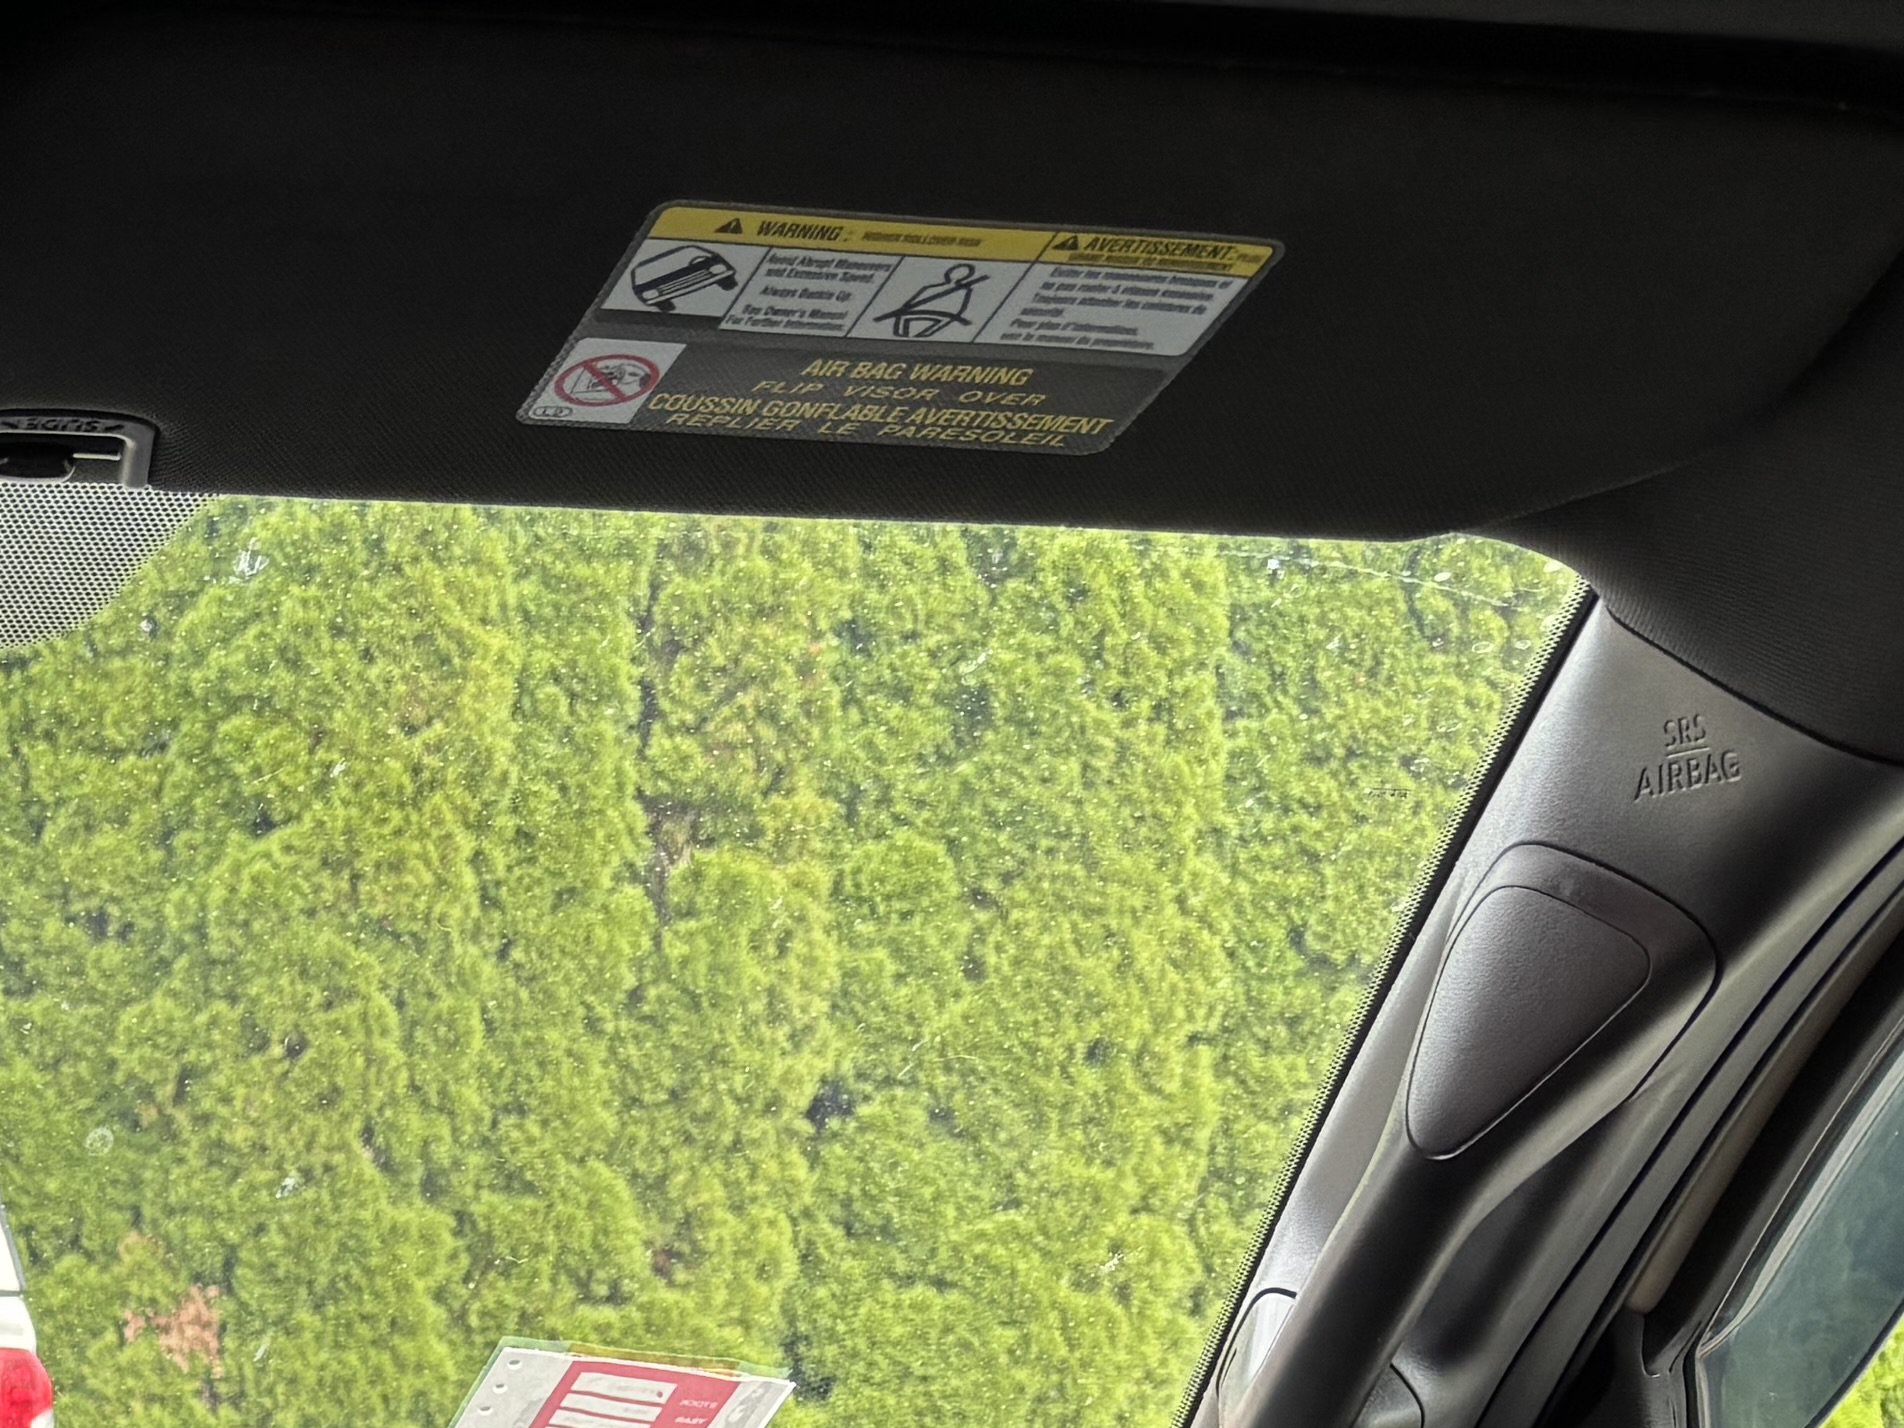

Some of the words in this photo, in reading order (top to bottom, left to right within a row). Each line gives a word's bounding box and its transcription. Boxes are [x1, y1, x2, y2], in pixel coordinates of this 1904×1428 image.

[801, 359, 851, 379] AIR
[854, 362, 905, 381] BAG
[908, 365, 1033, 386] WARNING
[751, 380, 824, 395] FLIP
[845, 386, 940, 400] VISOR
[958, 391, 1046, 407] OVER
[648, 393, 760, 416] COUSSIN
[762, 399, 907, 426] GONFLABLE
[906, 406, 1113, 436] AVERTISSEMENT
[665, 413, 800, 432] REPLIER
[819, 420, 862, 435] LE
[877, 425, 1067, 448] PARESOLEIL
[1663, 713, 1707, 750] SRS
[1632, 749, 1743, 804] AIRBAG
